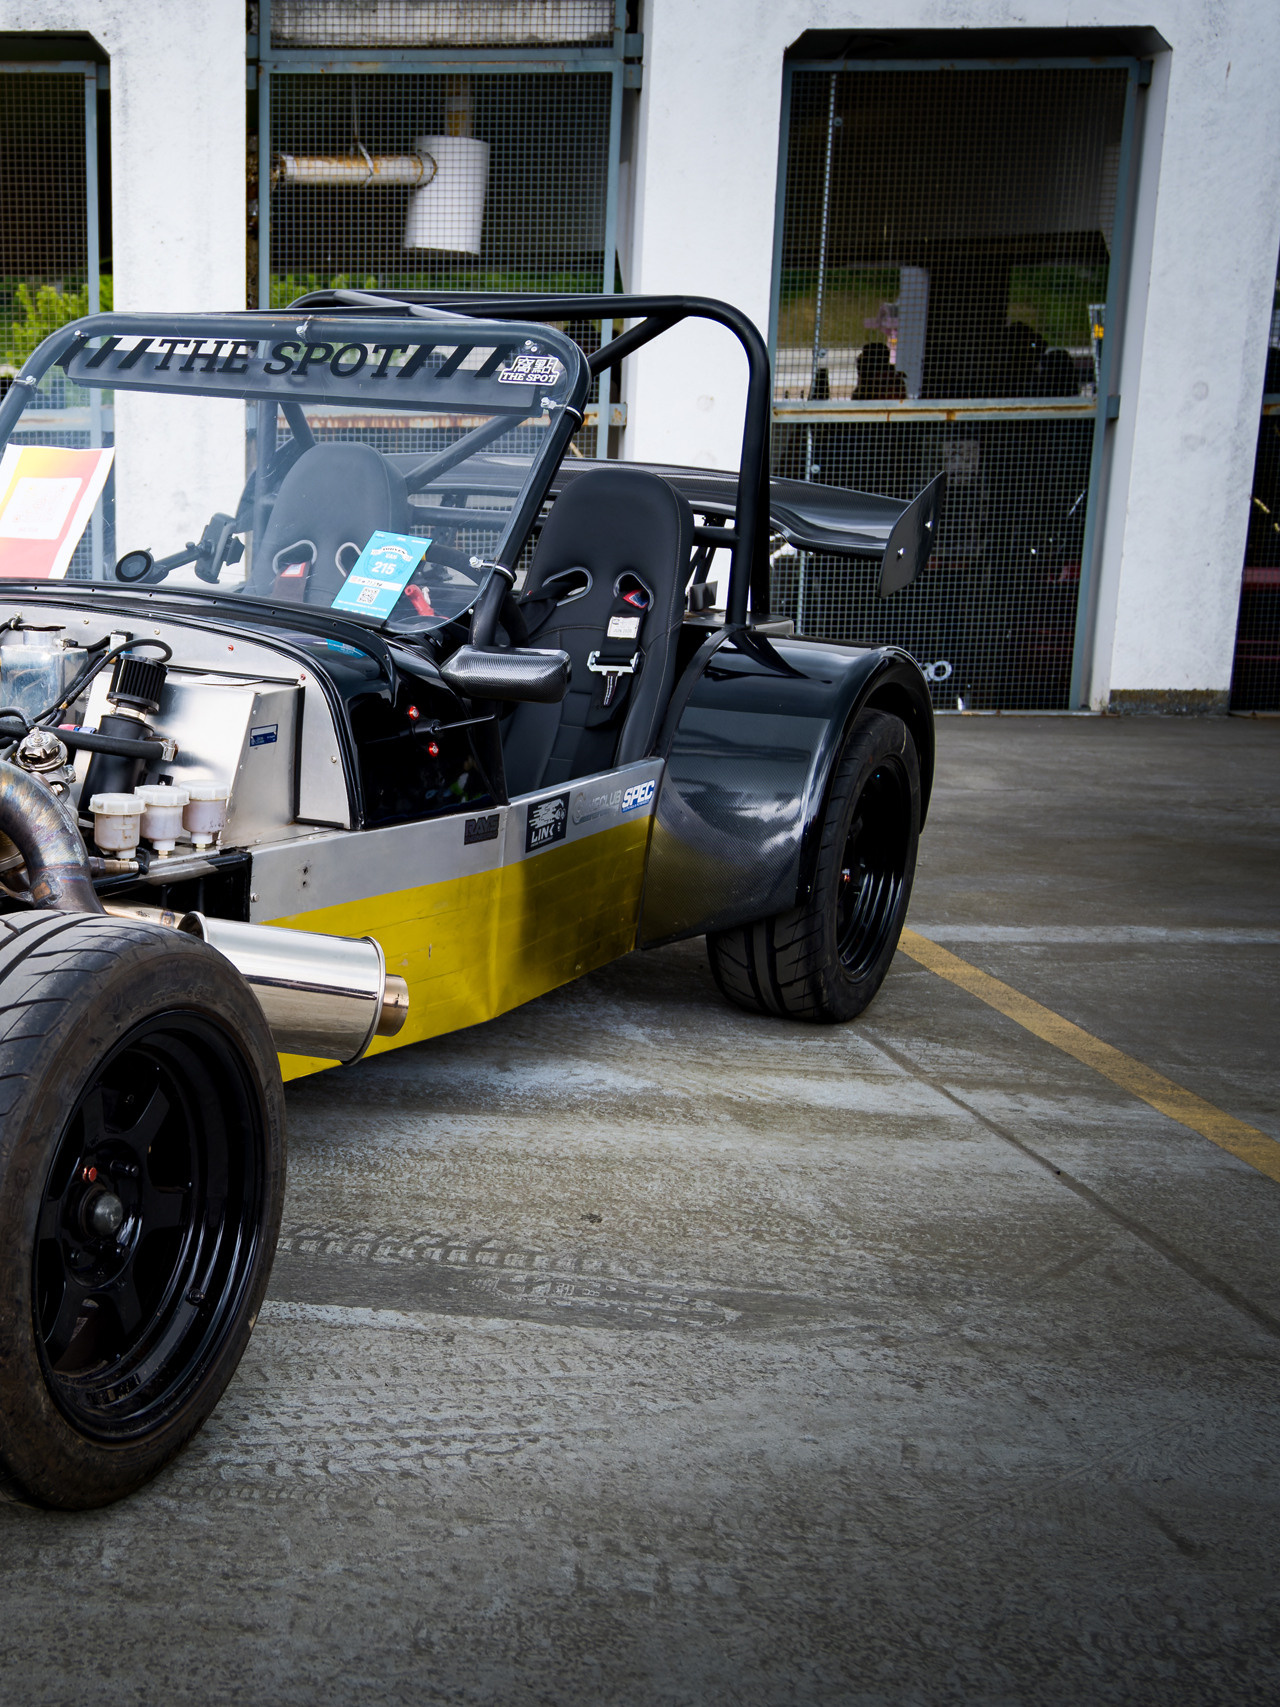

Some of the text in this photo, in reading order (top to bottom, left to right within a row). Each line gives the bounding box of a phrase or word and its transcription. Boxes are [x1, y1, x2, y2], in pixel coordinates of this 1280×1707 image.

[154, 339, 410, 378] THE SPOT
[503, 371, 557, 384] THE SPOT
[371, 560, 397, 576] 215
[622, 779, 655, 809] SPEC
[465, 814, 499, 835] RAYS
[531, 822, 556, 844] LINK
